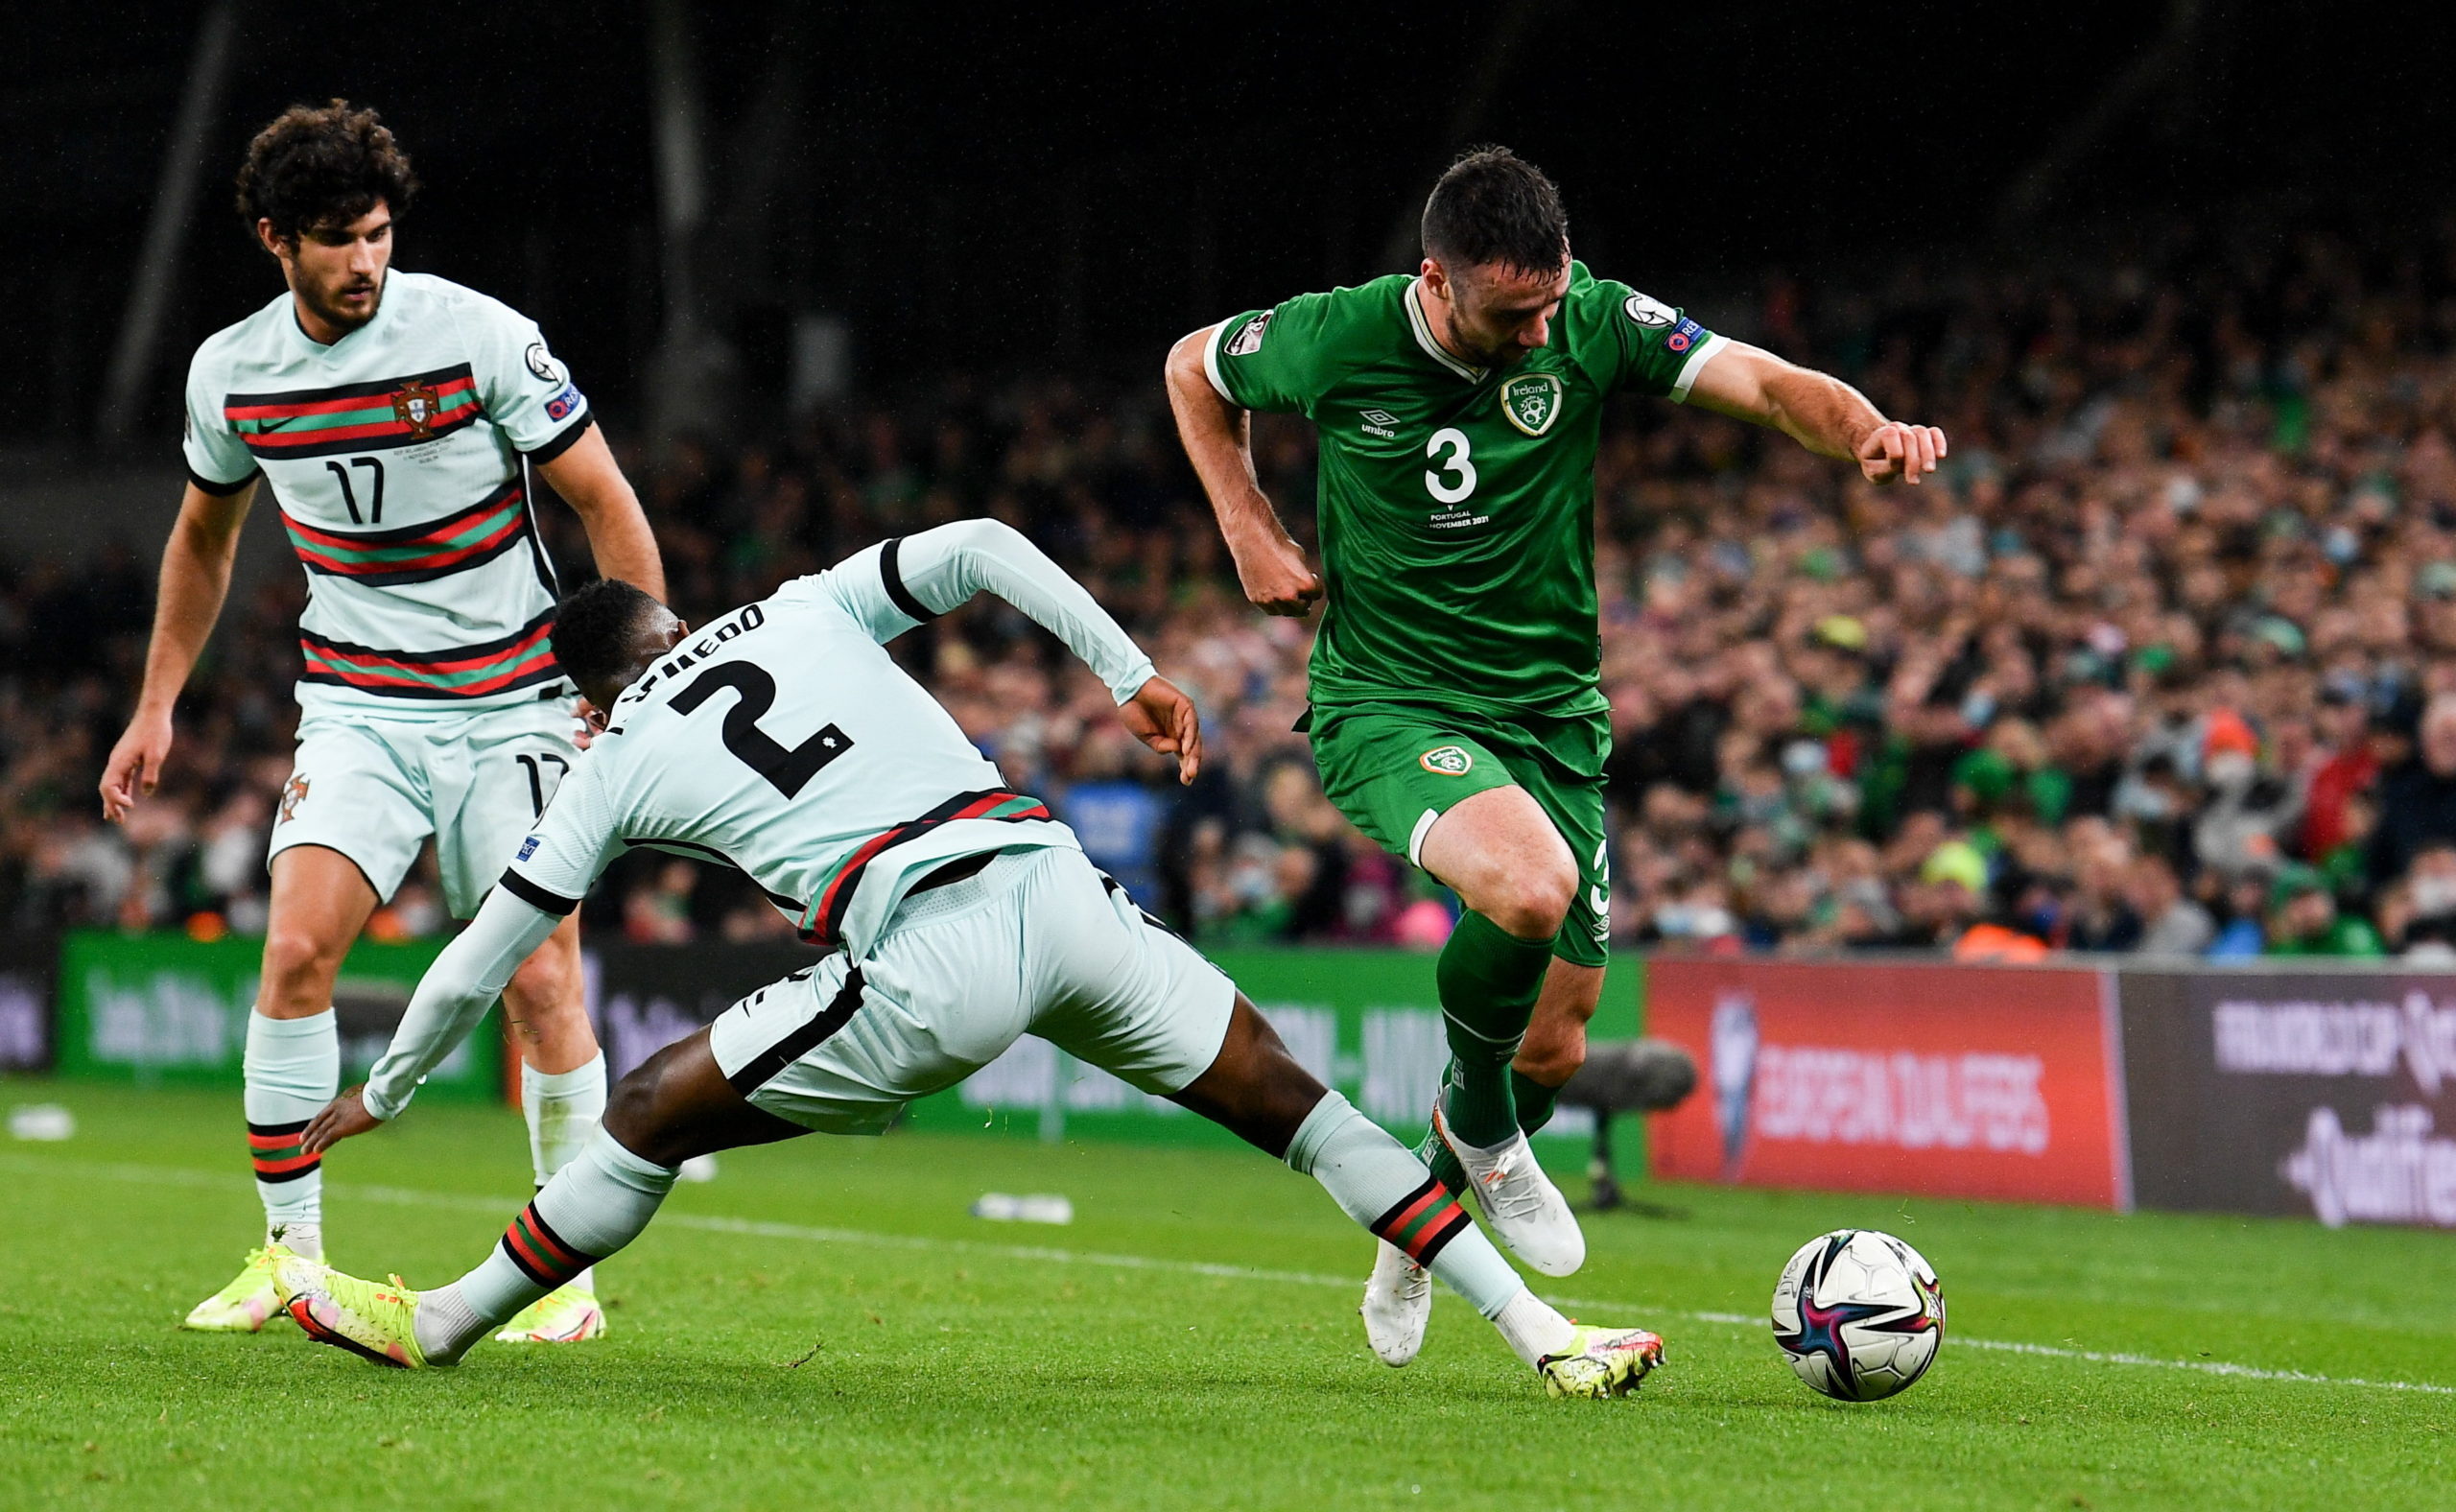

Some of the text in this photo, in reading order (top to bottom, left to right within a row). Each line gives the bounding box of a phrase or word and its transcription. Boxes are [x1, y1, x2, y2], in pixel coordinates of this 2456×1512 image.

[1512, 381, 1549, 396] Ireland
[1361, 423, 1395, 438] umbro
[1425, 427, 1477, 505] 3
[326, 456, 385, 525] 17
[1429, 509, 1472, 522] PORTUGAL
[1472, 514, 1490, 526] 2021
[667, 659, 855, 801] 2
